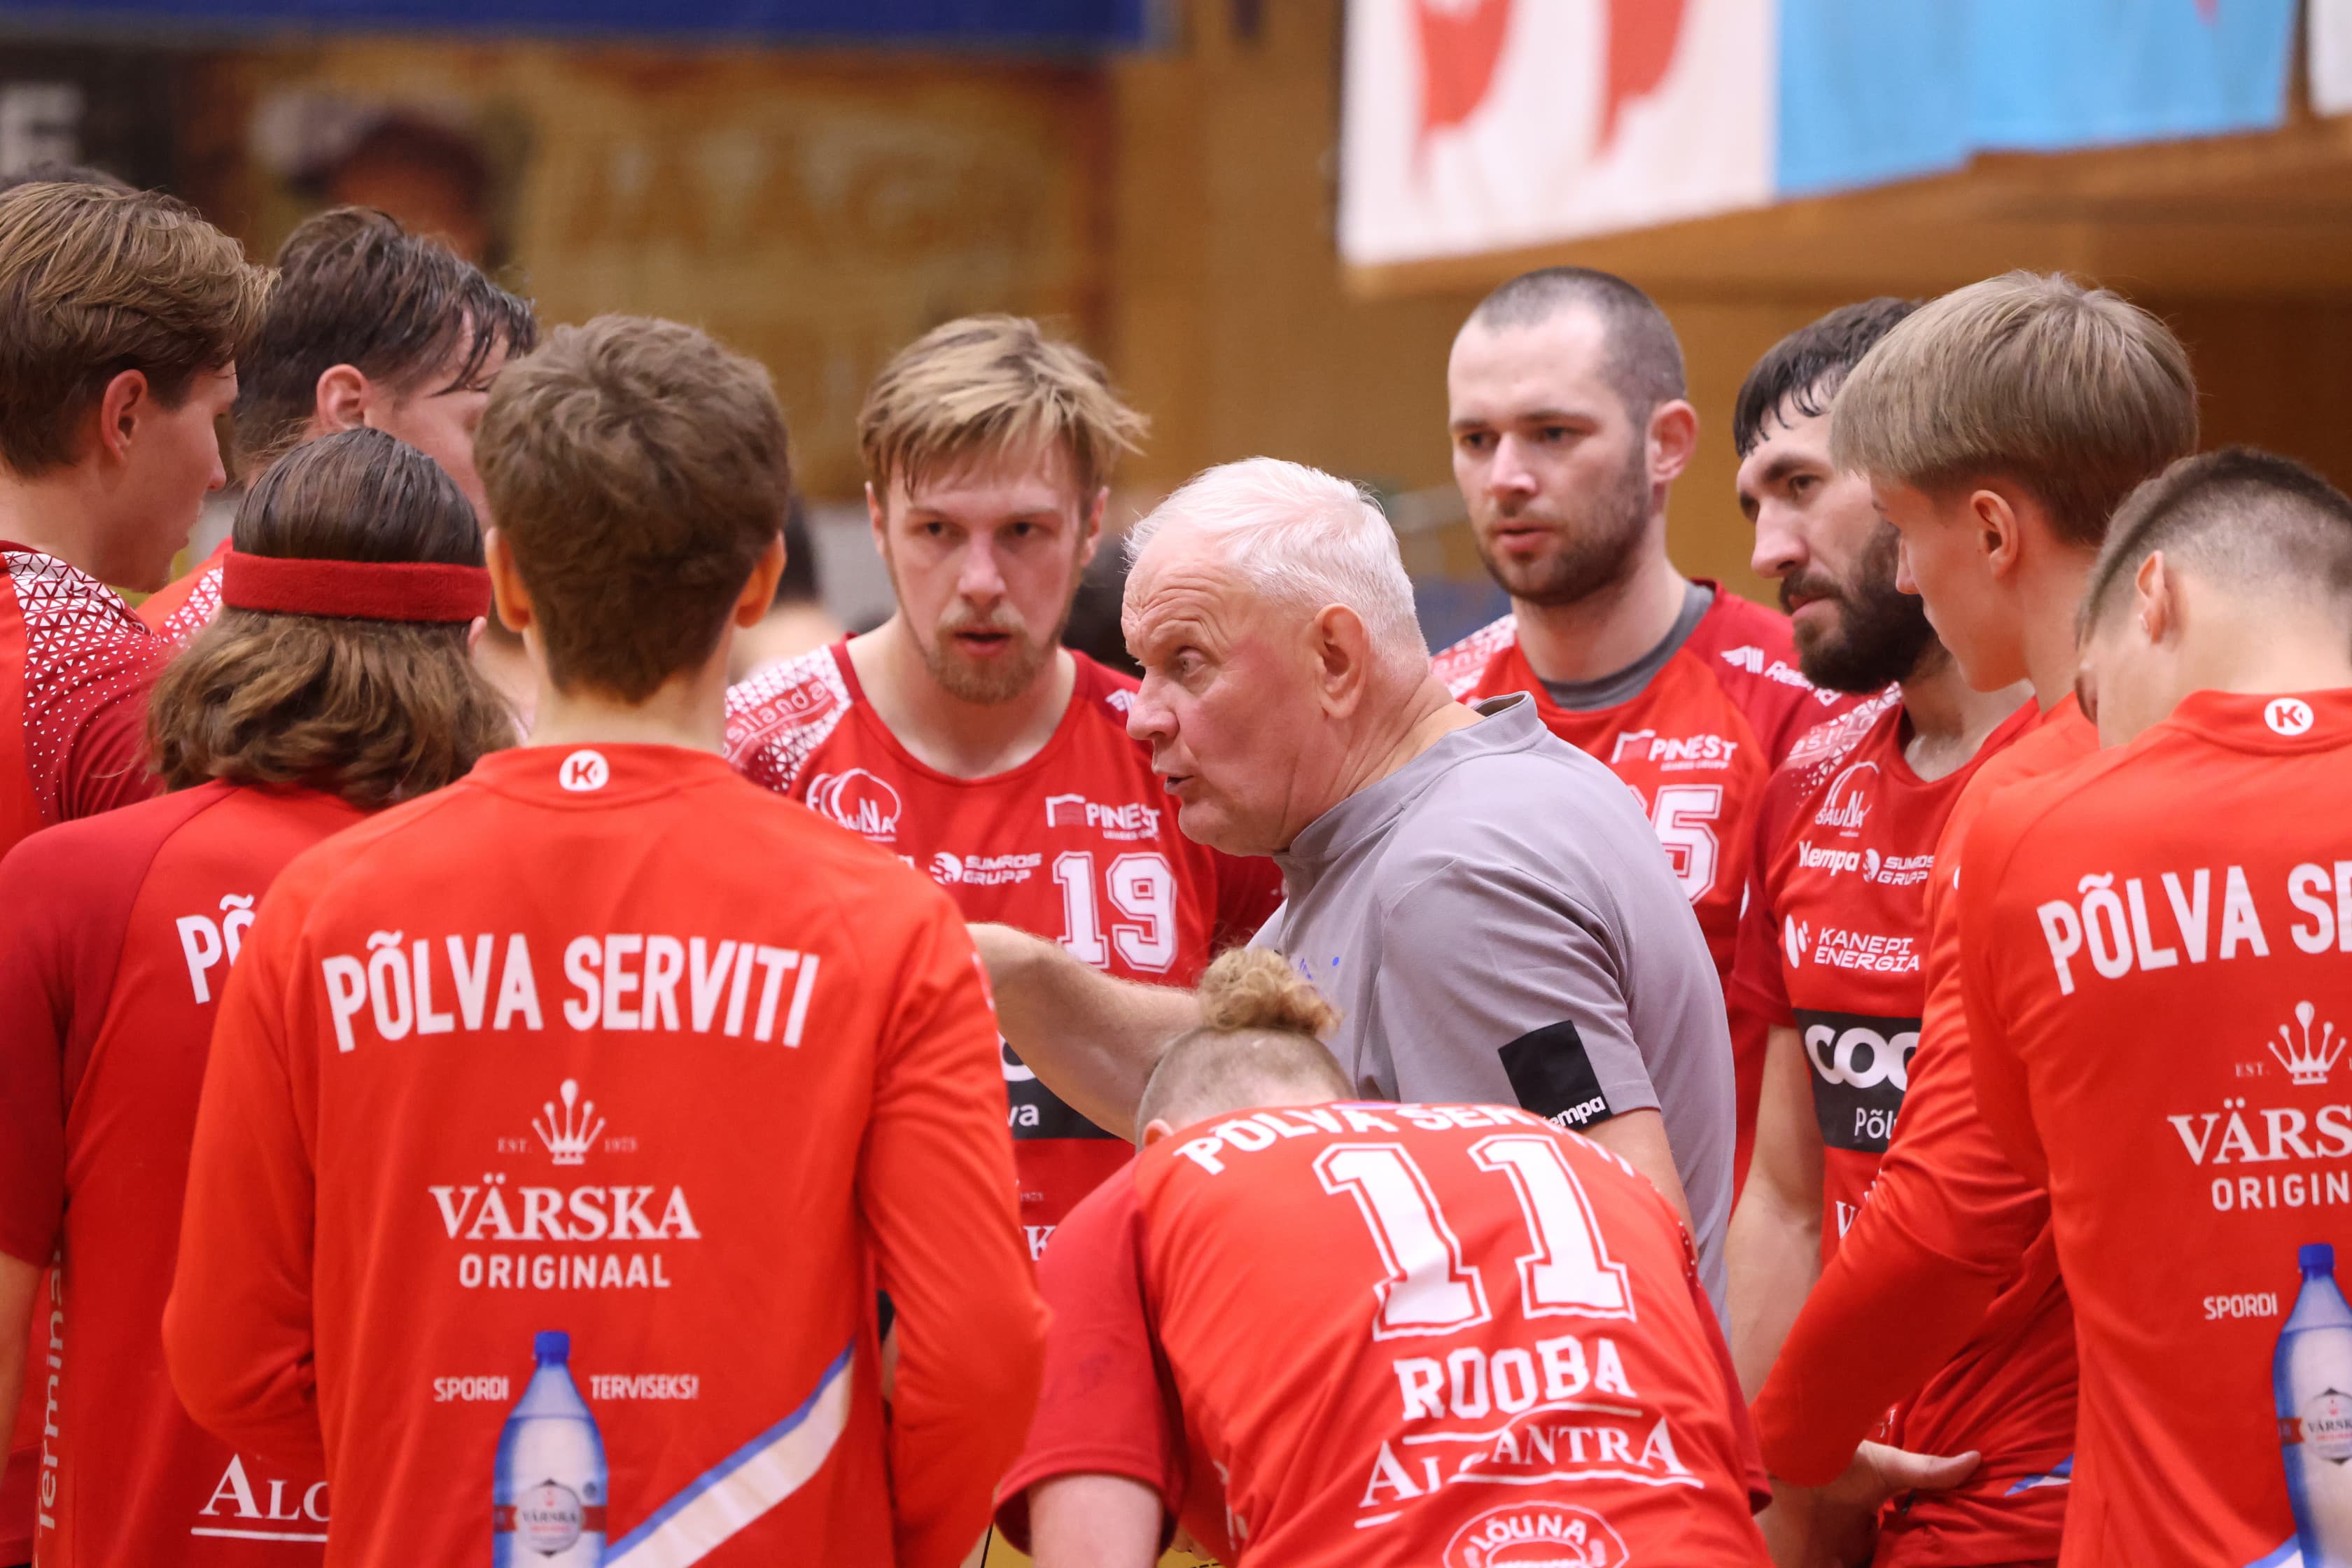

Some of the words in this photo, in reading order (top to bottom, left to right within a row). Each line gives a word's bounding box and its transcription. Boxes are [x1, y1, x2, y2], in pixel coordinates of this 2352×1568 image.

[1648, 734, 1738, 762] PINEST
[1628, 784, 1723, 905] 5
[1798, 841, 1861, 876] Kempa
[962, 869, 1032, 885] GRUPP
[1052, 850, 1177, 973] 19
[1819, 927, 1914, 955] KANEPI
[2036, 864, 2271, 995] PÕLVA
[1814, 946, 1920, 972] ENERGIA
[321, 930, 544, 1053] PÕLVA
[563, 934, 820, 1049] SERVITI
[1541, 1096, 1606, 1128] empa
[428, 1172, 701, 1241] VÄRSKA
[1312, 1134, 1636, 1340] 11
[459, 1254, 671, 1290] ORIGINAAL
[2203, 1293, 2278, 1321] SPORDI
[433, 1376, 509, 1402] SPORDI
[589, 1373, 699, 1400] TERVISEKS!
[1393, 1335, 1637, 1422] ROOBA
